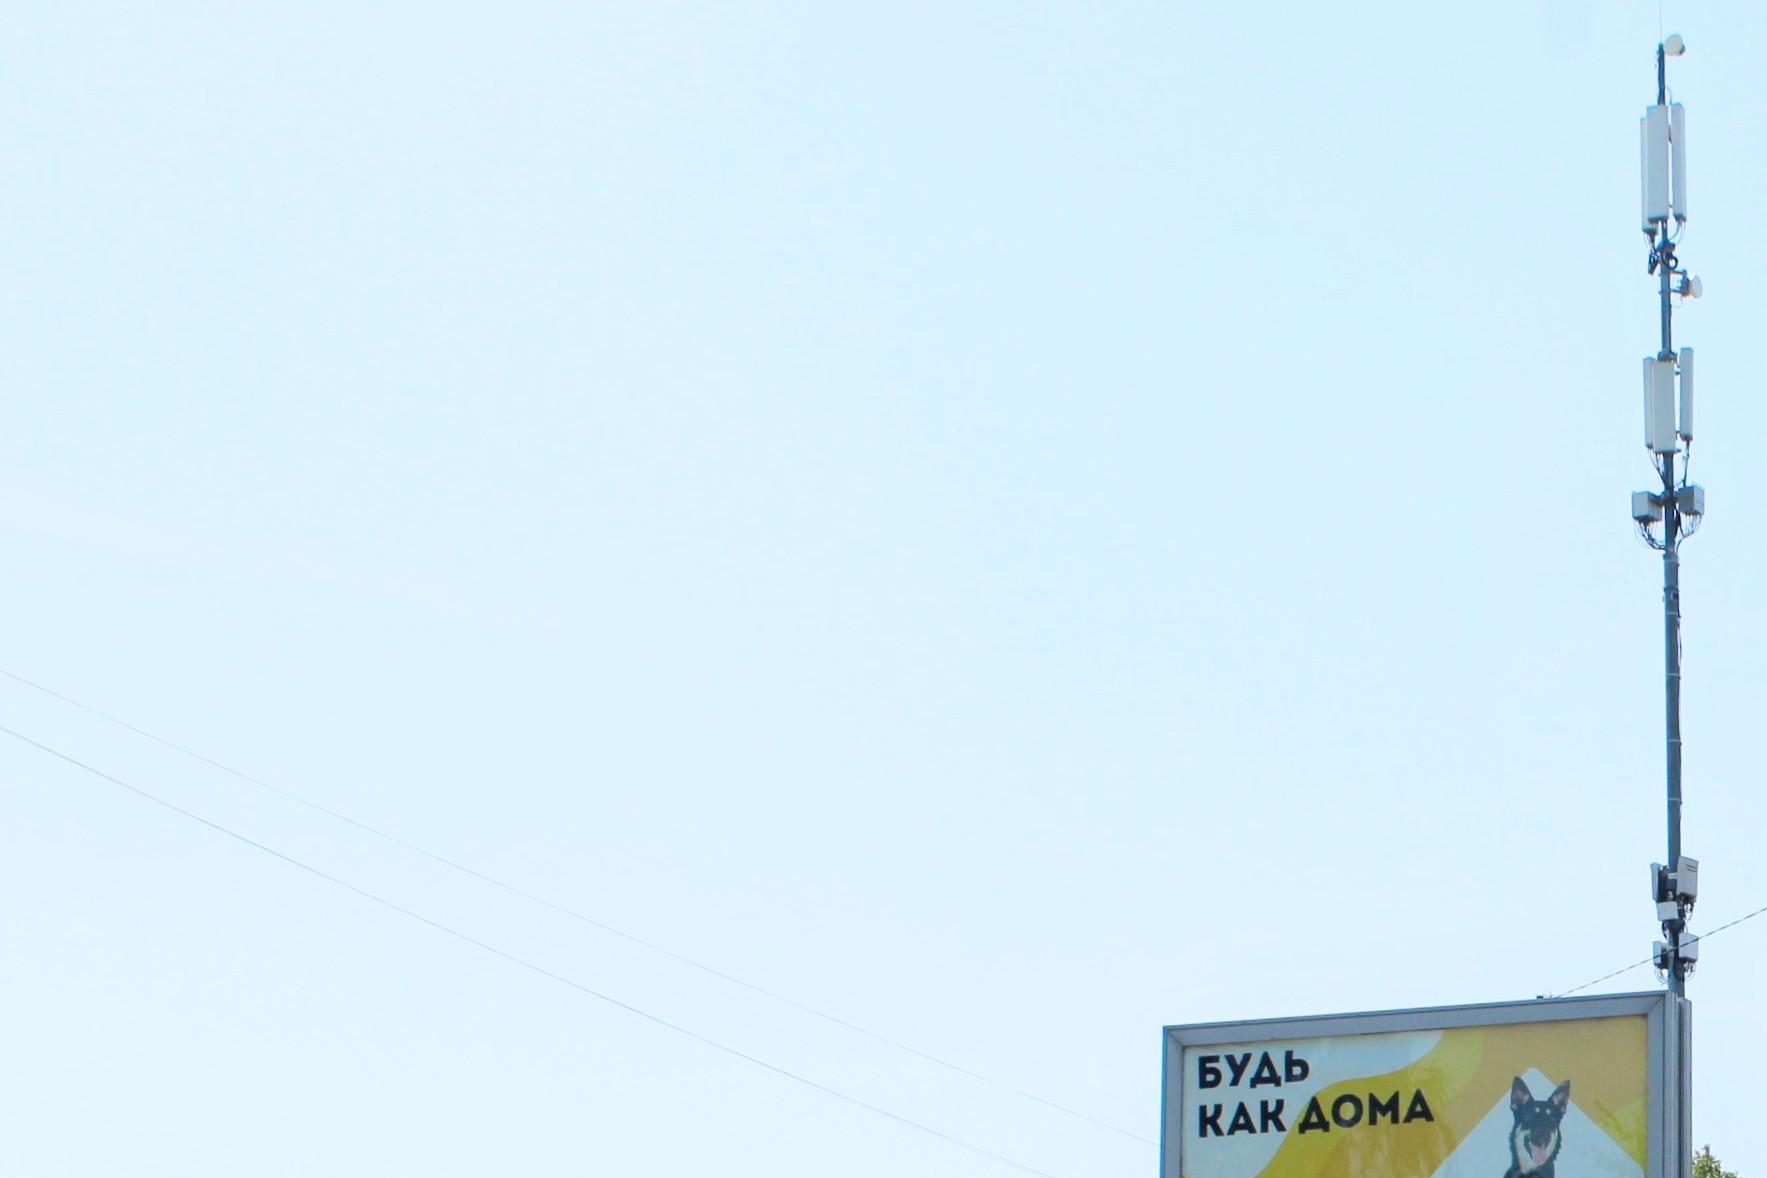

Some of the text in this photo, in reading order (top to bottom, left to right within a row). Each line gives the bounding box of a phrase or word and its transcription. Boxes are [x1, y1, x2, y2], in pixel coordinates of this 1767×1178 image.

[1198, 1050, 1310, 1089] БУДЬ
[1198, 1088, 1435, 1138] КАК ДОМА
